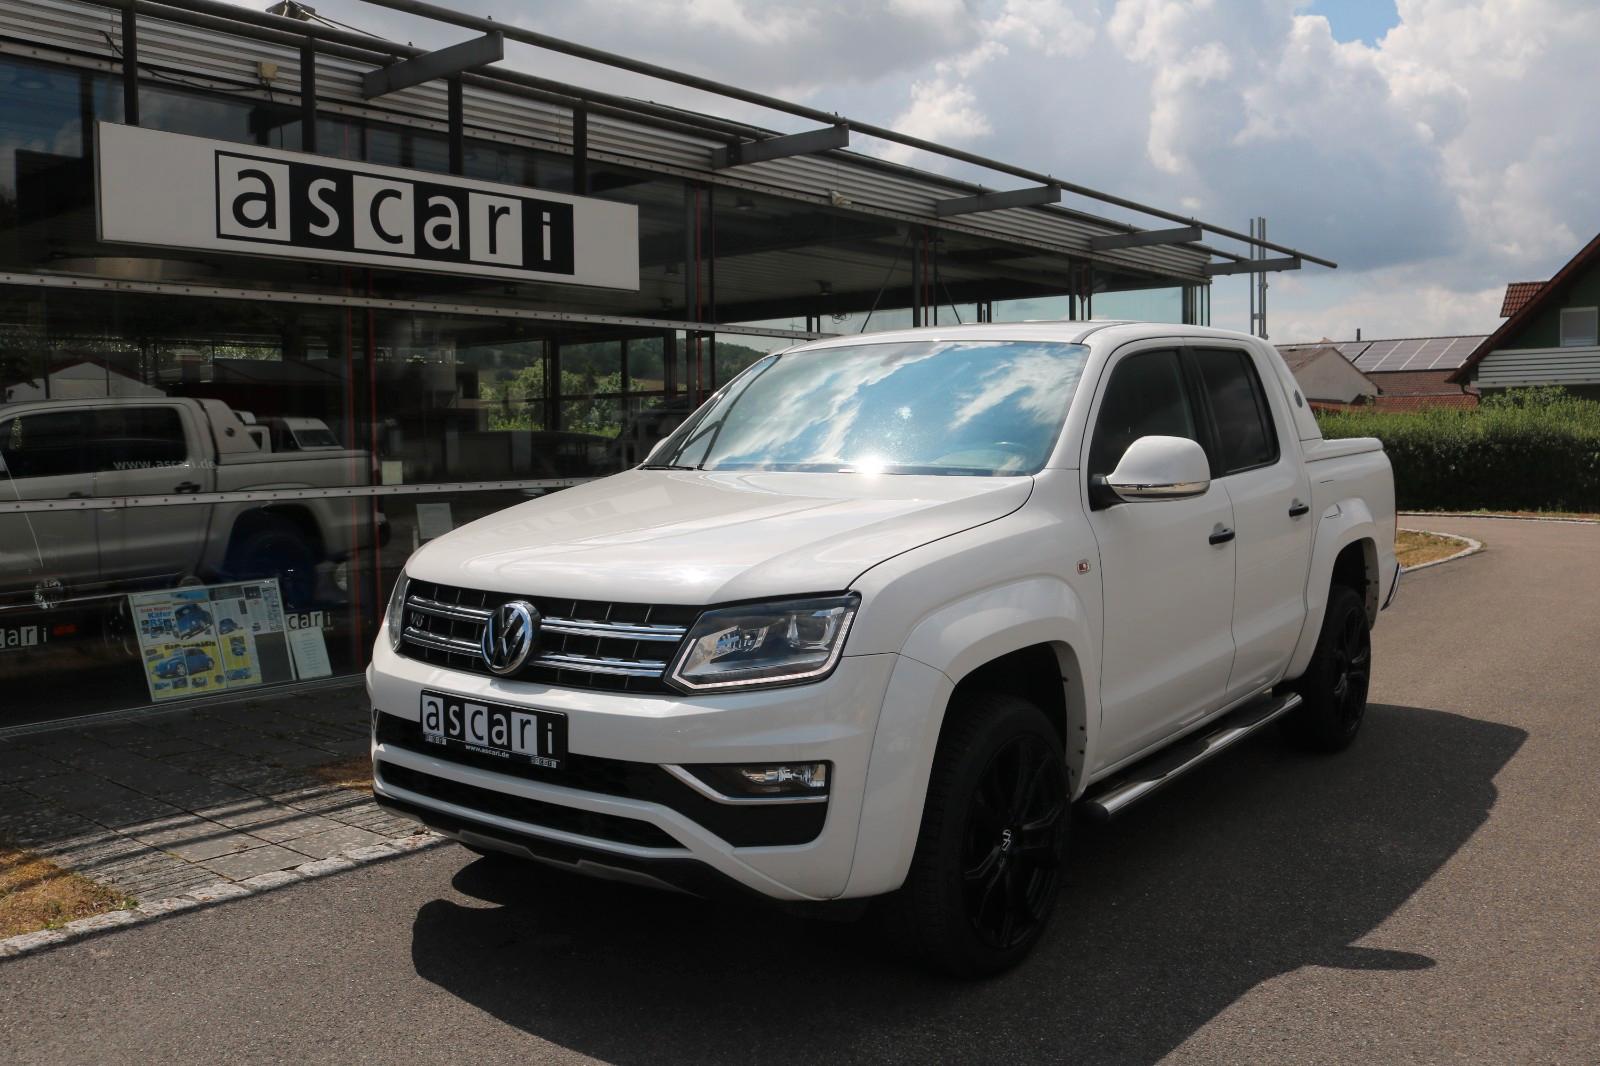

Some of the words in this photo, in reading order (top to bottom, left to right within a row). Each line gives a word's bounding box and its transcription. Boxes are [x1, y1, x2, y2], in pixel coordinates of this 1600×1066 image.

[231, 168, 551, 262] ascari
[0, 626, 48, 648] ari
[425, 700, 553, 755] ascari
[465, 744, 510, 759] www.ascari.de
